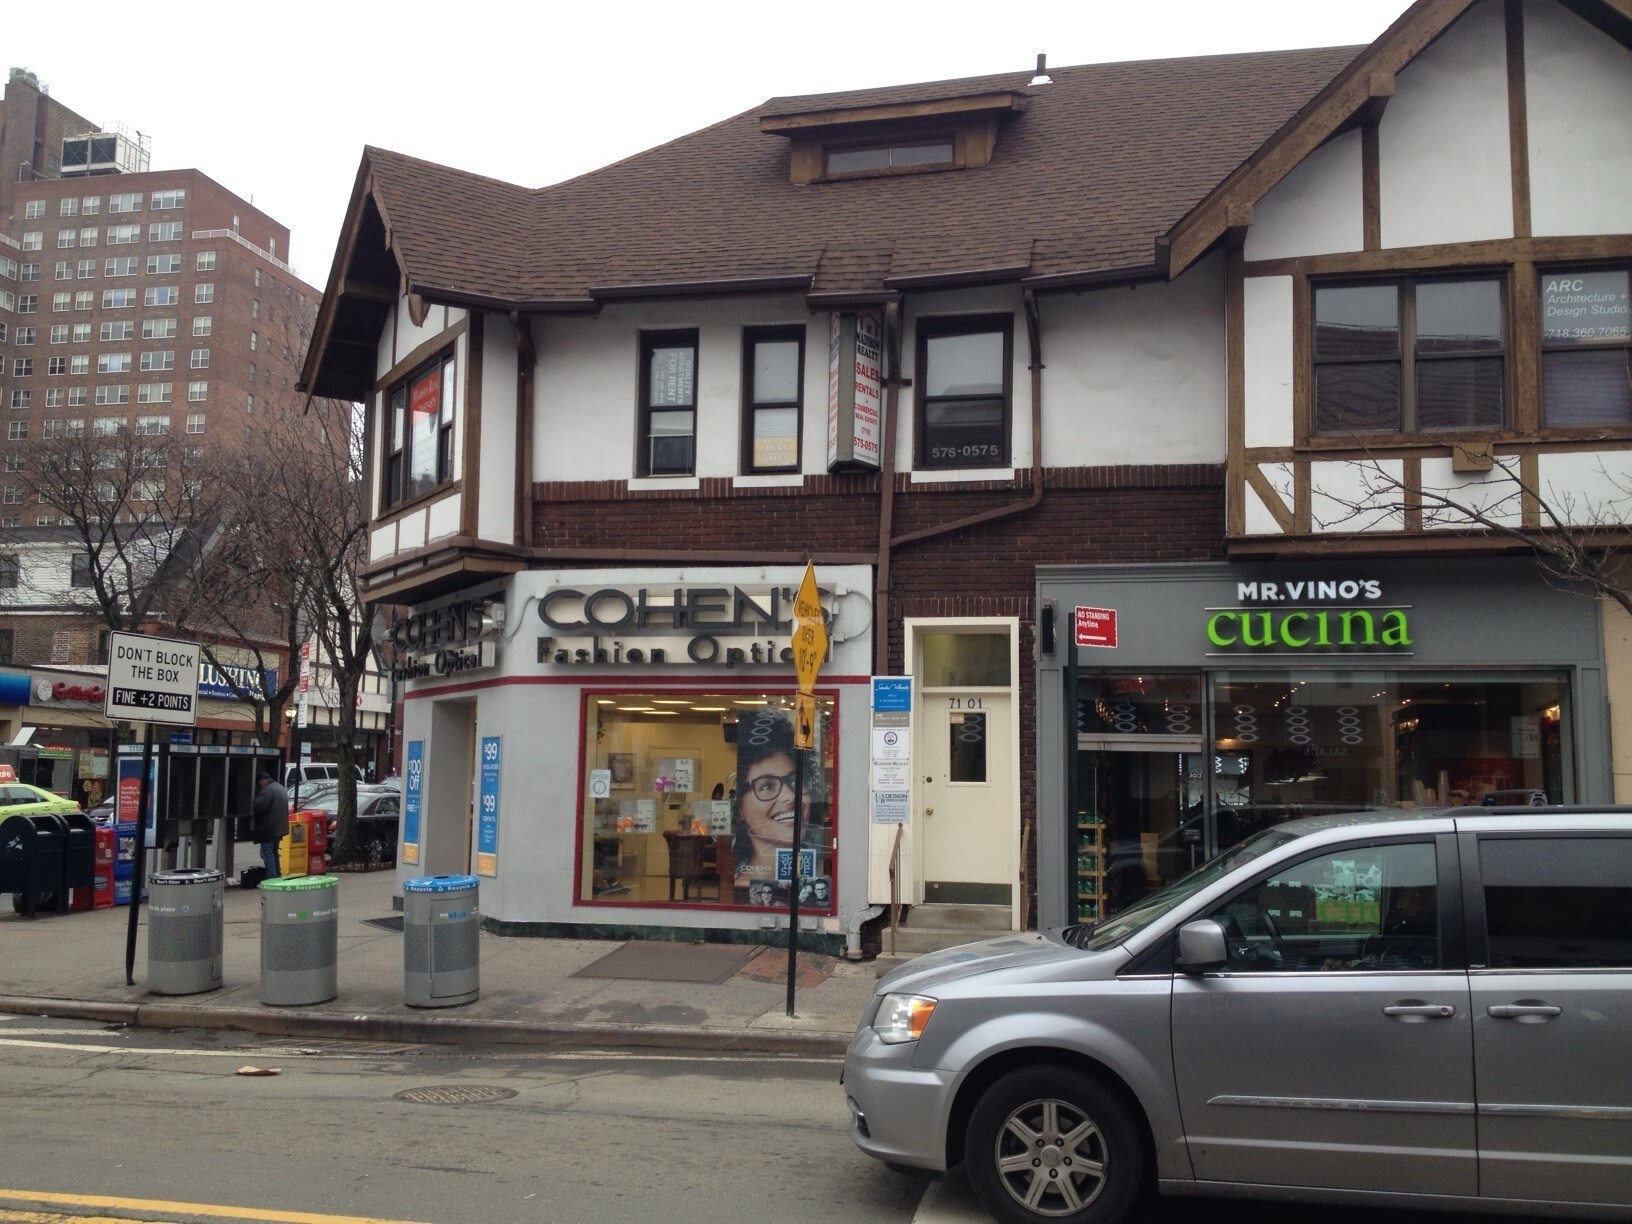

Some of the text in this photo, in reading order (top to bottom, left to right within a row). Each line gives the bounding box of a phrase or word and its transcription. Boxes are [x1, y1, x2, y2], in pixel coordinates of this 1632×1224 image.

[1546, 279, 1583, 293] ARC
[1547, 293, 1617, 304] Architecture
[1547, 304, 1628, 318] Design Studio
[858, 344, 879, 362] REALTY
[667, 353, 677, 402] FOR RENT
[856, 362, 880, 383] SALES
[855, 382, 879, 399] RENTALS
[853, 436, 878, 453] 575-0575
[1237, 579, 1382, 600] MR.VINO'S
[1078, 620, 1099, 629] Anytime
[1086, 612, 1110, 621] STANDING
[394, 598, 484, 654] COHEN'S
[1207, 609, 1413, 647] cucina
[117, 646, 193, 668] DON'T BLOCK
[434, 641, 483, 678] Optical
[537, 634, 834, 669] Fashion Opticl
[131, 665, 179, 683] THE BOX
[115, 690, 136, 705] FINE
[140, 693, 155, 707] +2
[158, 694, 189, 709] POINTS
[327, 692, 341, 708] HS
[129, 745, 144, 753] TITA
[484, 742, 497, 760] $99
[408, 759, 422, 775] $100
[409, 776, 420, 790] Off
[483, 795, 495, 812] $99
[781, 854, 812, 862] SHW
[781, 867, 811, 877] STE
